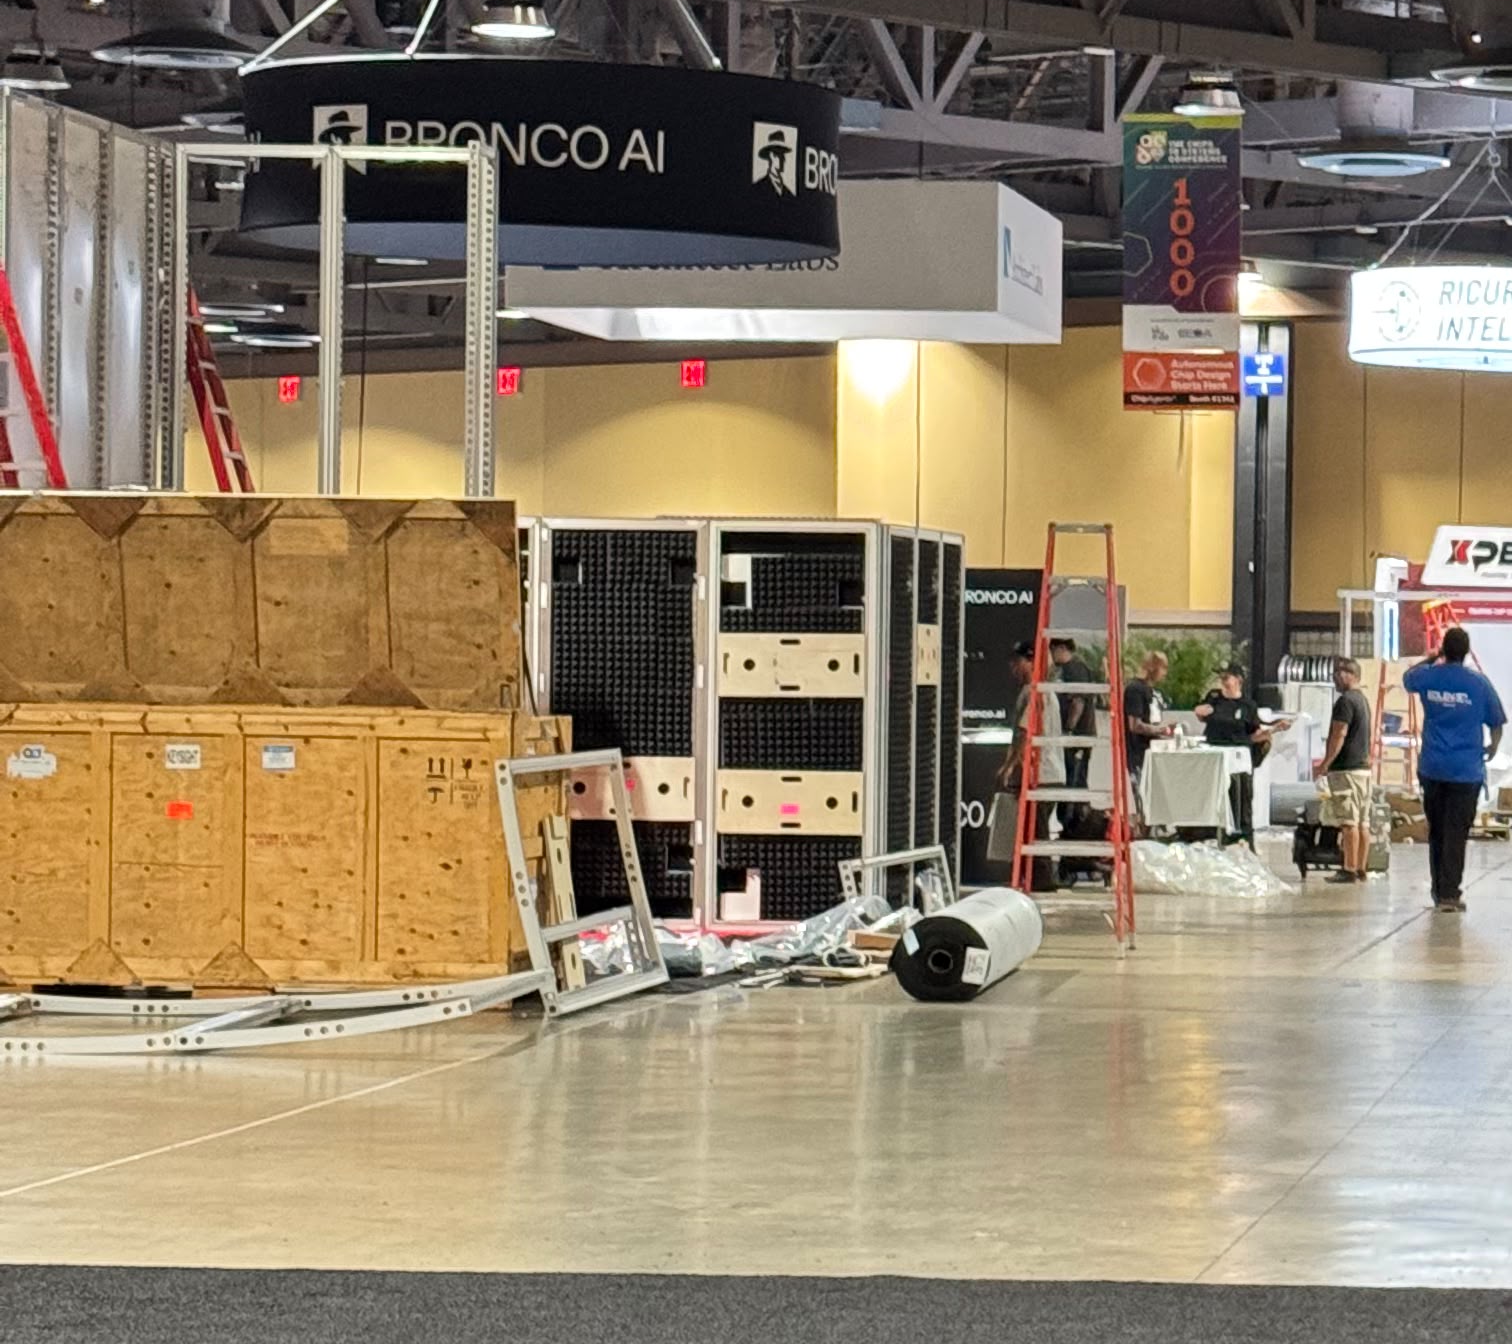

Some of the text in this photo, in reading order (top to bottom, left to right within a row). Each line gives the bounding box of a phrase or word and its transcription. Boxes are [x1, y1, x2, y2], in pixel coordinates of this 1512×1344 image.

[618, 128, 665, 174] AI
[1169, 177, 1195, 297] 1000
[1019, 590, 1034, 605] AI
